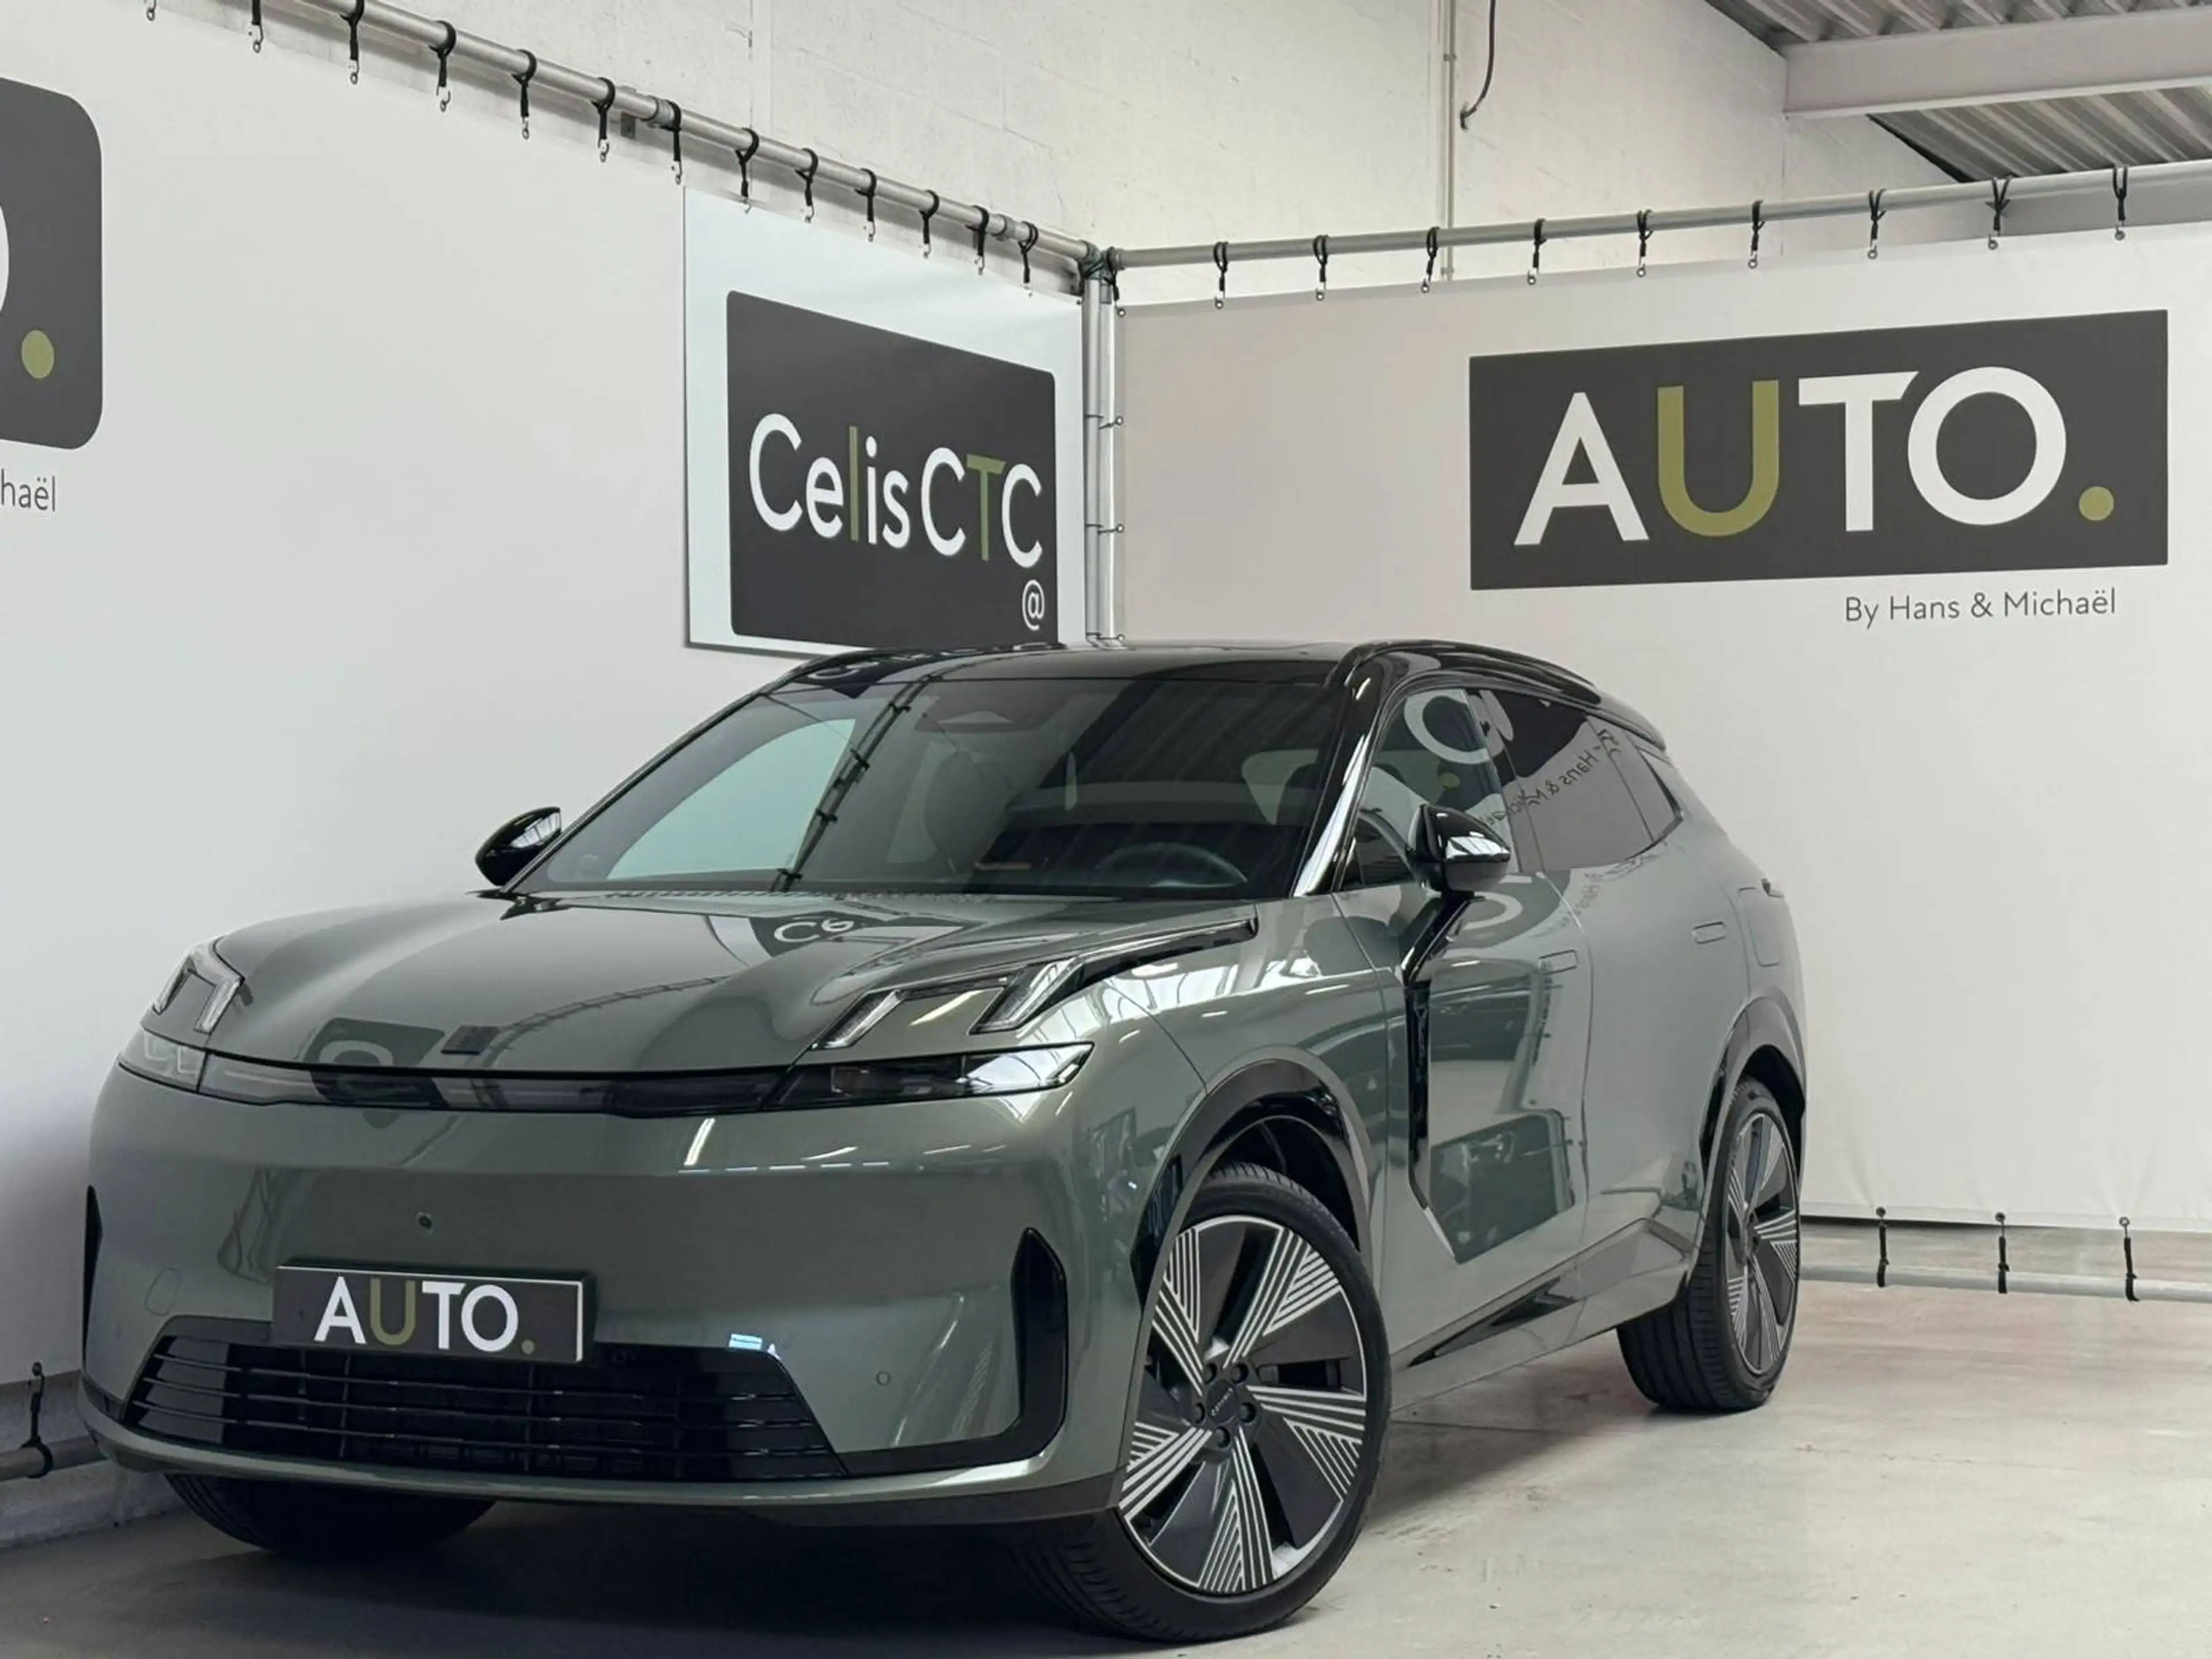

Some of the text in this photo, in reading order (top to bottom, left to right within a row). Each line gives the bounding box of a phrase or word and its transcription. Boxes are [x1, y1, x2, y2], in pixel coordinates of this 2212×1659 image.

[749, 412, 1043, 569] CelisCTC
[1513, 366, 2115, 546] AUTO.
[1021, 579, 1046, 631] @
[1845, 587, 2115, 630] By Hans & Michaël
[313, 1275, 535, 1355] AUTO.
